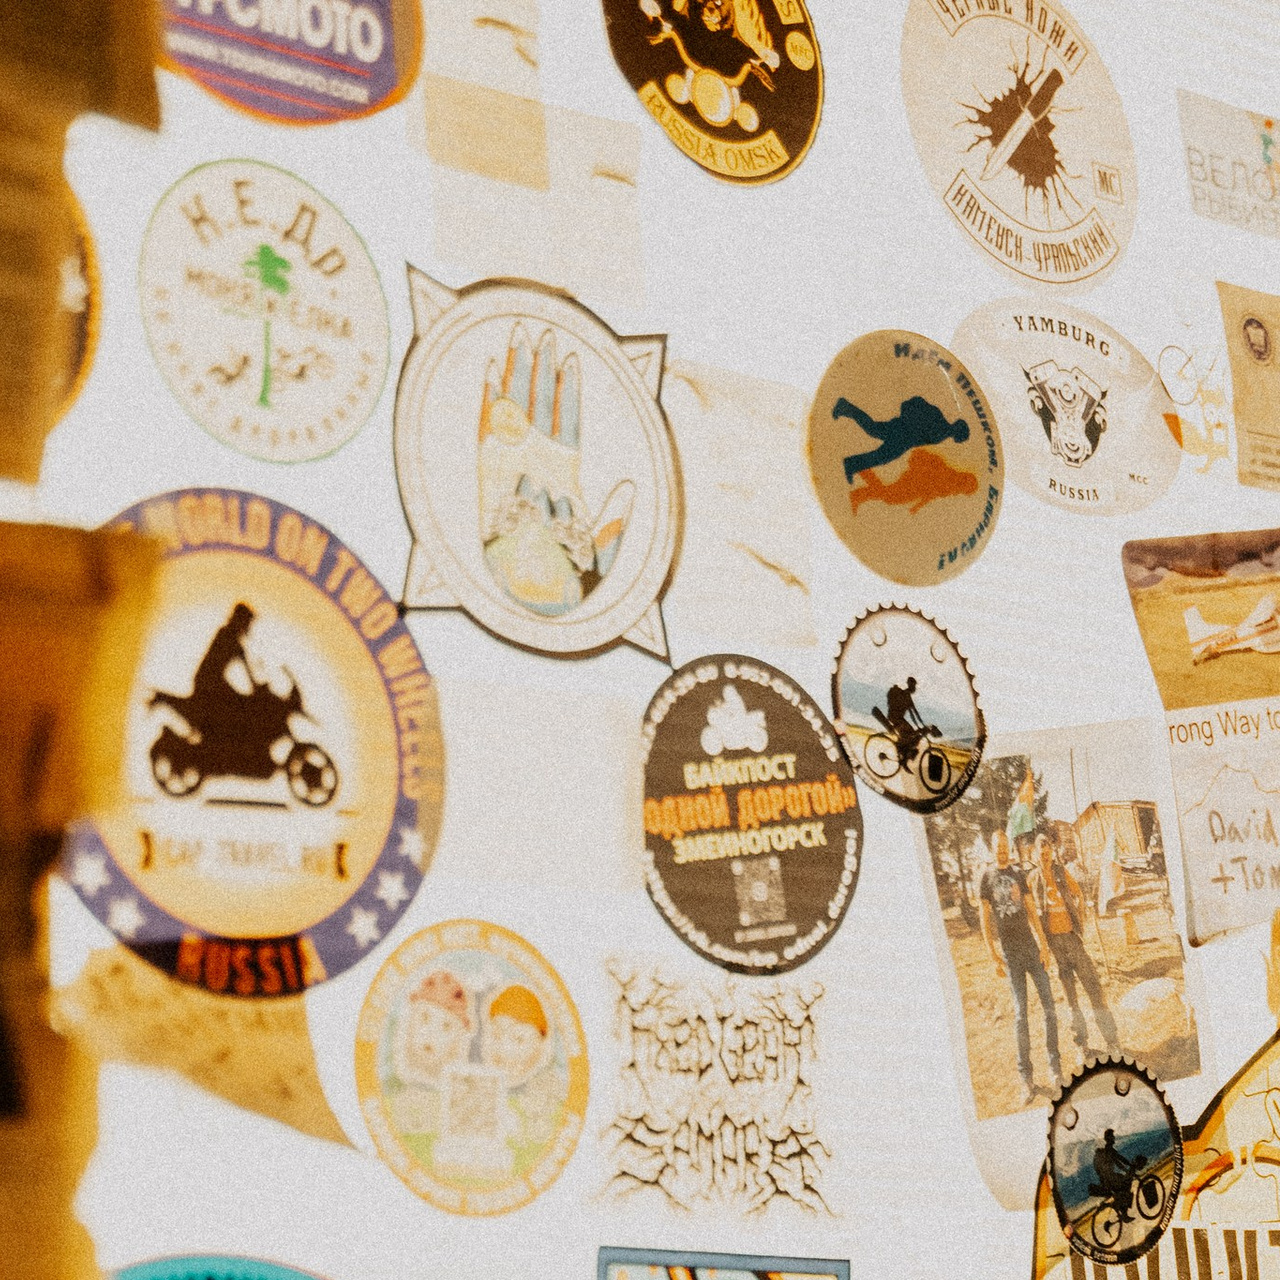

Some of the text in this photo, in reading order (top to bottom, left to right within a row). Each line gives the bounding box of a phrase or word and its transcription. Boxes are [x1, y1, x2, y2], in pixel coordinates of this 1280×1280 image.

[645, 92, 783, 172] RUSSIA OMSK
[1012, 314, 1112, 358] YAMBURG
[1048, 477, 1101, 503] RUSSIA
[273, 513, 330, 578] ON
[325, 549, 398, 642] TWO
[1215, 709, 1264, 741] Way
[682, 754, 798, 791] БАЙКПОСТ
[1208, 810, 1280, 848] David
